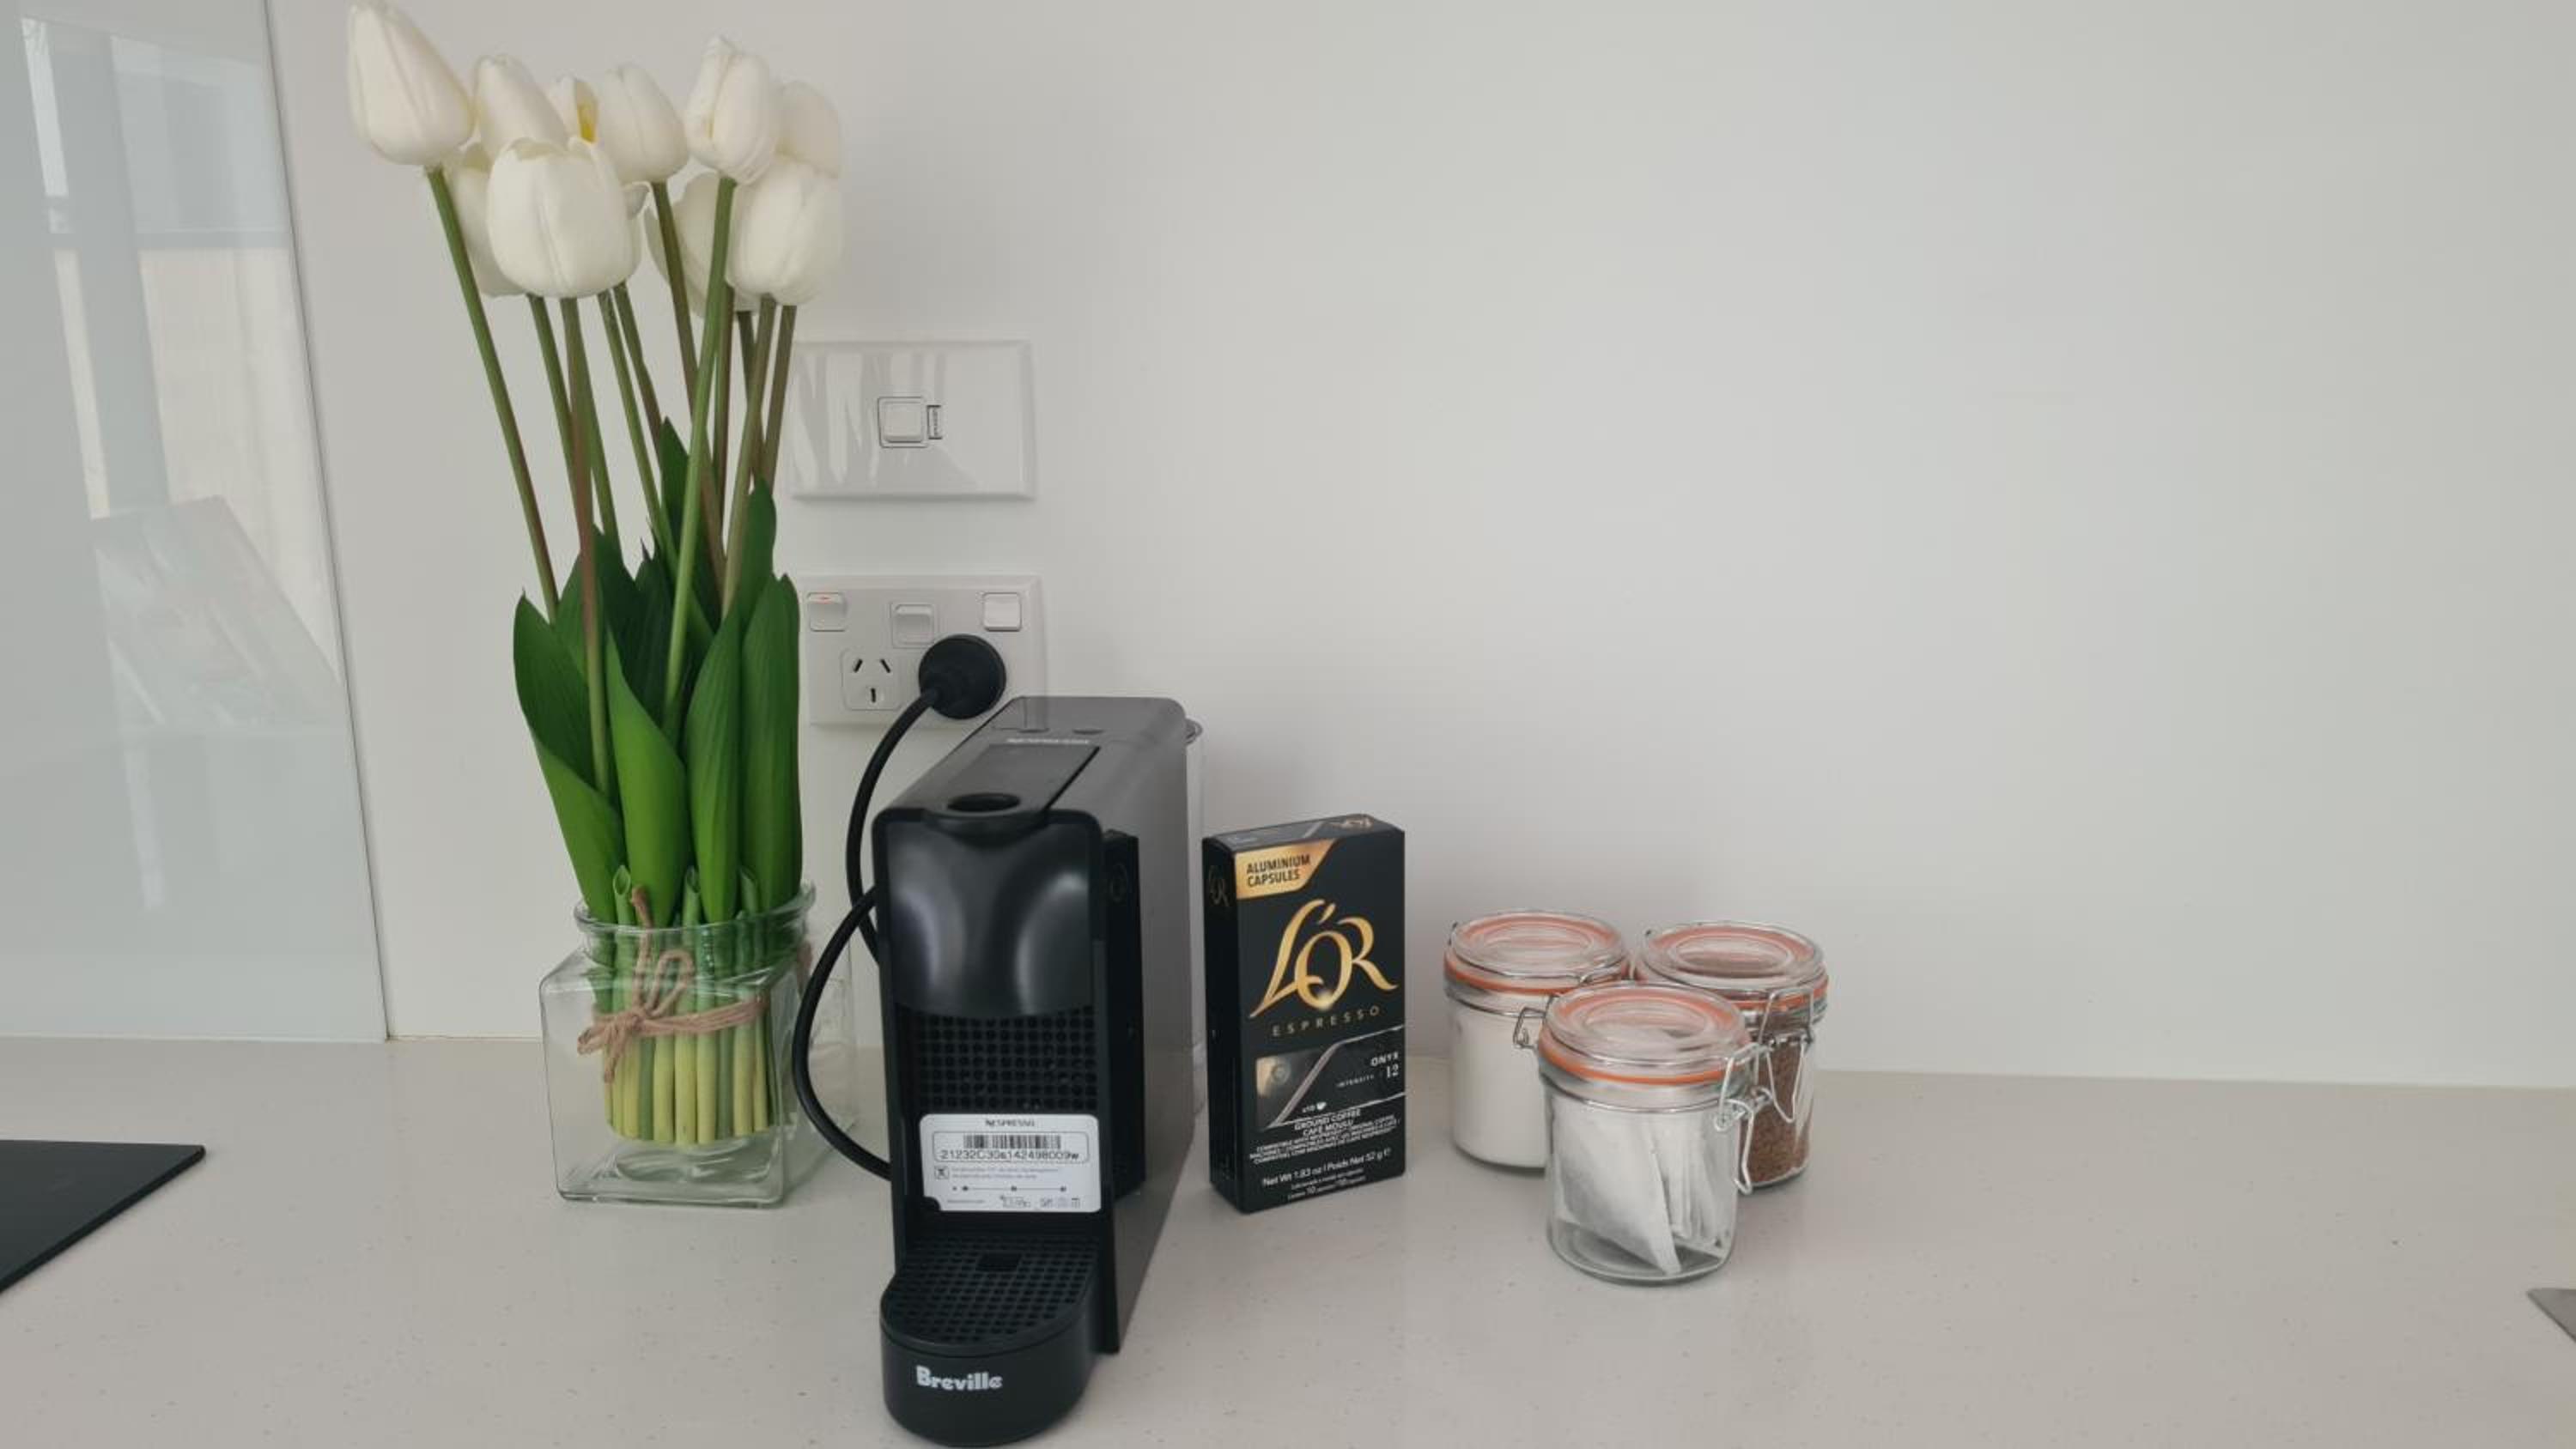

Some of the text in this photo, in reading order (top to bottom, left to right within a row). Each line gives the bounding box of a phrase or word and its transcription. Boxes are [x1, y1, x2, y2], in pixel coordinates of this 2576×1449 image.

[1247, 854, 1310, 874] ALUMINIUM
[1248, 870, 1299, 888] CAPSULES
[1273, 1006, 1381, 1037] ESPRESSO
[1370, 1051, 1400, 1067] ONYX
[1386, 1063, 1400, 1078] 12
[1294, 1108, 1362, 1131] GROUND COFFEE
[1262, 1175, 1279, 1186] Net
[1294, 1168, 1311, 1179] 1.83
[1350, 1156, 1364, 1167] Net
[916, 1365, 1004, 1391] Breville
